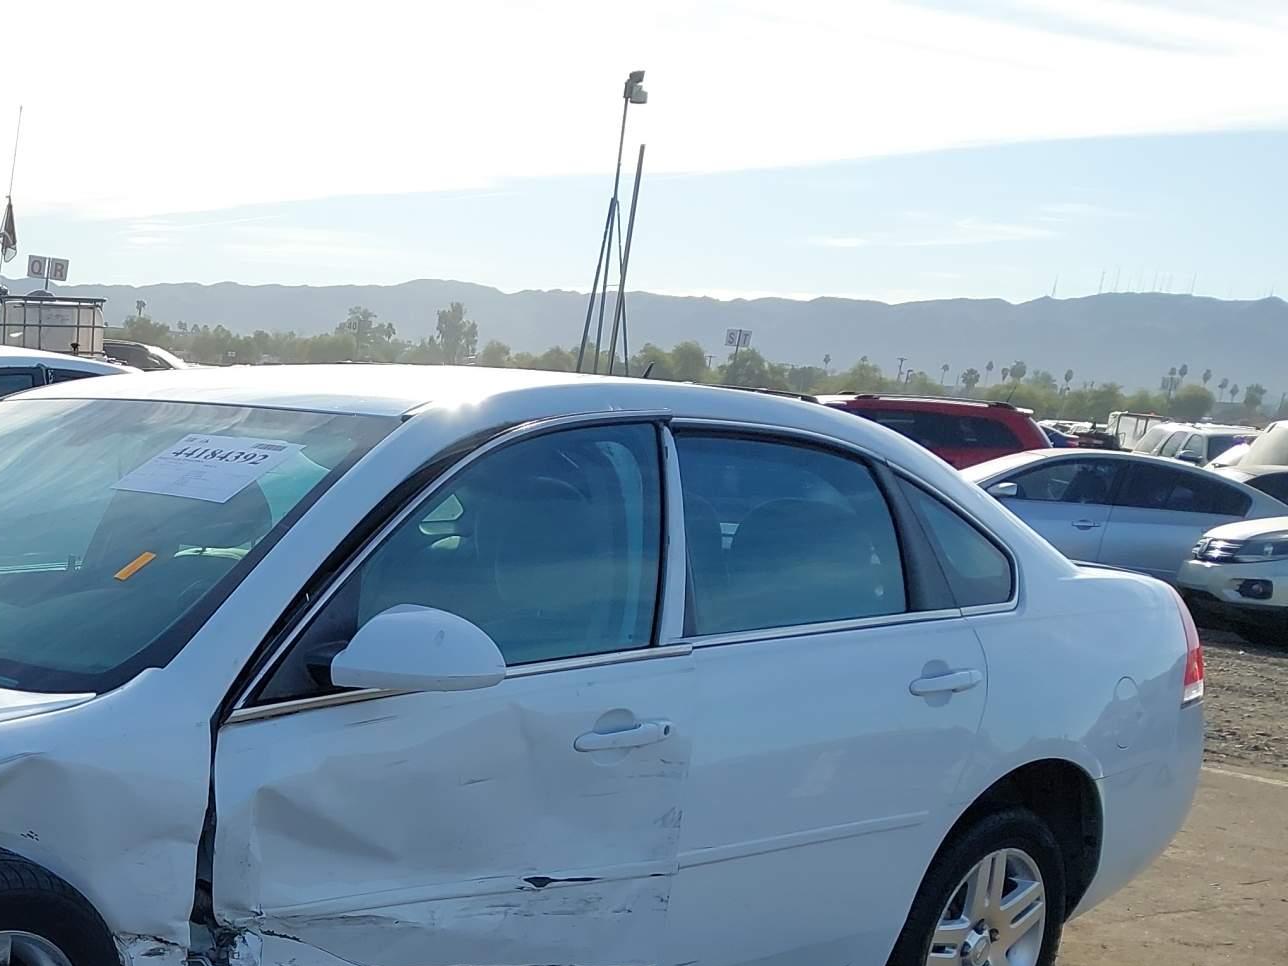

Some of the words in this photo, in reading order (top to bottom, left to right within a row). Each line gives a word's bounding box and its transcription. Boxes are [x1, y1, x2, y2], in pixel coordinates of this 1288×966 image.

[31, 259, 42, 276] Q
[54, 262, 65, 278] R
[727, 332, 736, 345] S
[743, 333, 750, 345] T
[171, 446, 270, 465] 44184392
